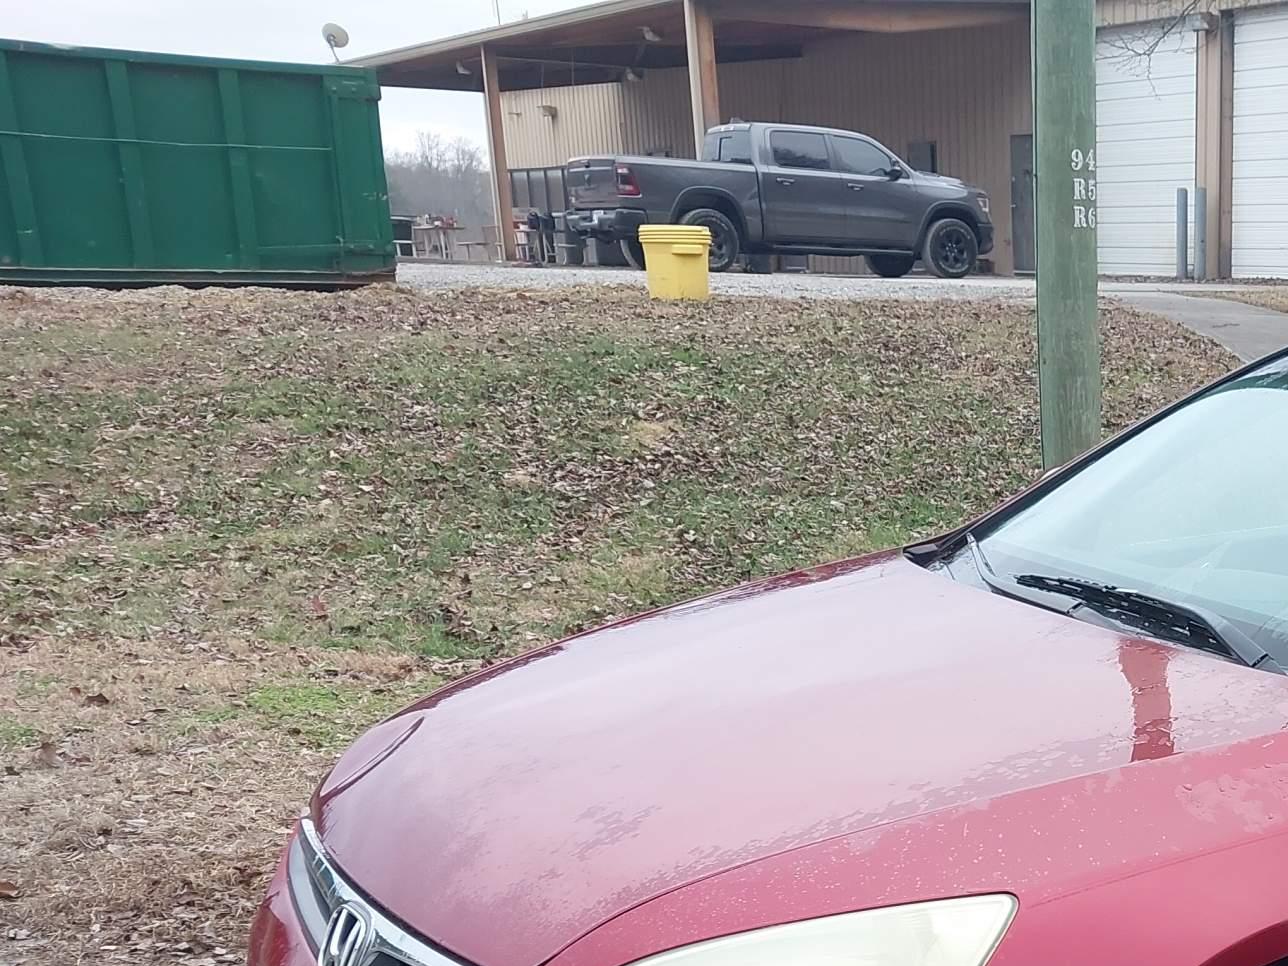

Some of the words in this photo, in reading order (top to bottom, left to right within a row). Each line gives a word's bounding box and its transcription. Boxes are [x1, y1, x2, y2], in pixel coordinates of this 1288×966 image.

[1071, 148, 1096, 171] 94
[1073, 178, 1096, 201] R5
[1073, 205, 1096, 229] R6
